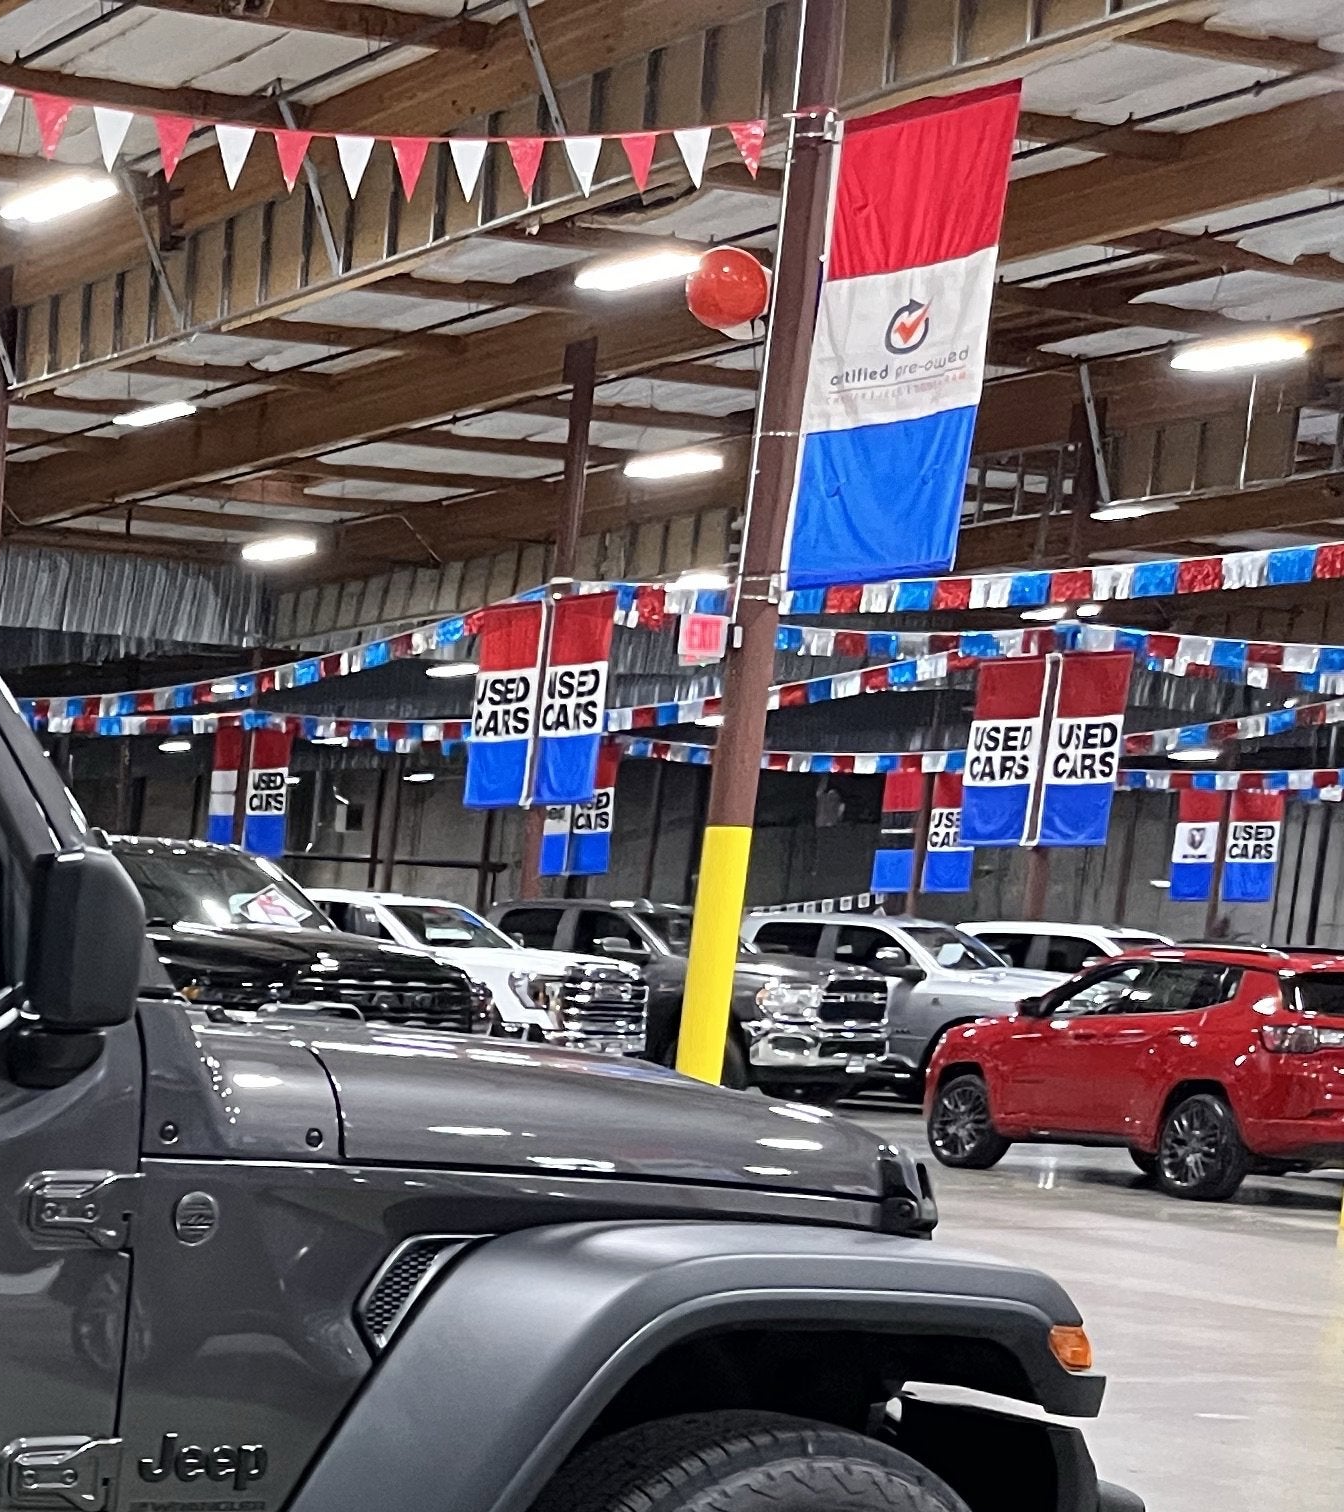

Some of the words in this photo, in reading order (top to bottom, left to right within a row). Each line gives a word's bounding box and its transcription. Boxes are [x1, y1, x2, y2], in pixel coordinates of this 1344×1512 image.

[830, 363, 889, 386] ctified
[895, 345, 969, 381] pre-owed
[476, 676, 530, 705] USED
[547, 669, 600, 699] USED
[474, 707, 529, 737] CARS
[542, 701, 598, 731] CARS
[973, 726, 1032, 752] USED
[1058, 722, 1118, 750] USED
[969, 755, 1030, 781] CARS
[1053, 752, 1115, 778] CARS
[1232, 825, 1275, 841] USED
[1229, 843, 1274, 860] CARS
[137, 1432, 268, 1491] Jeep
